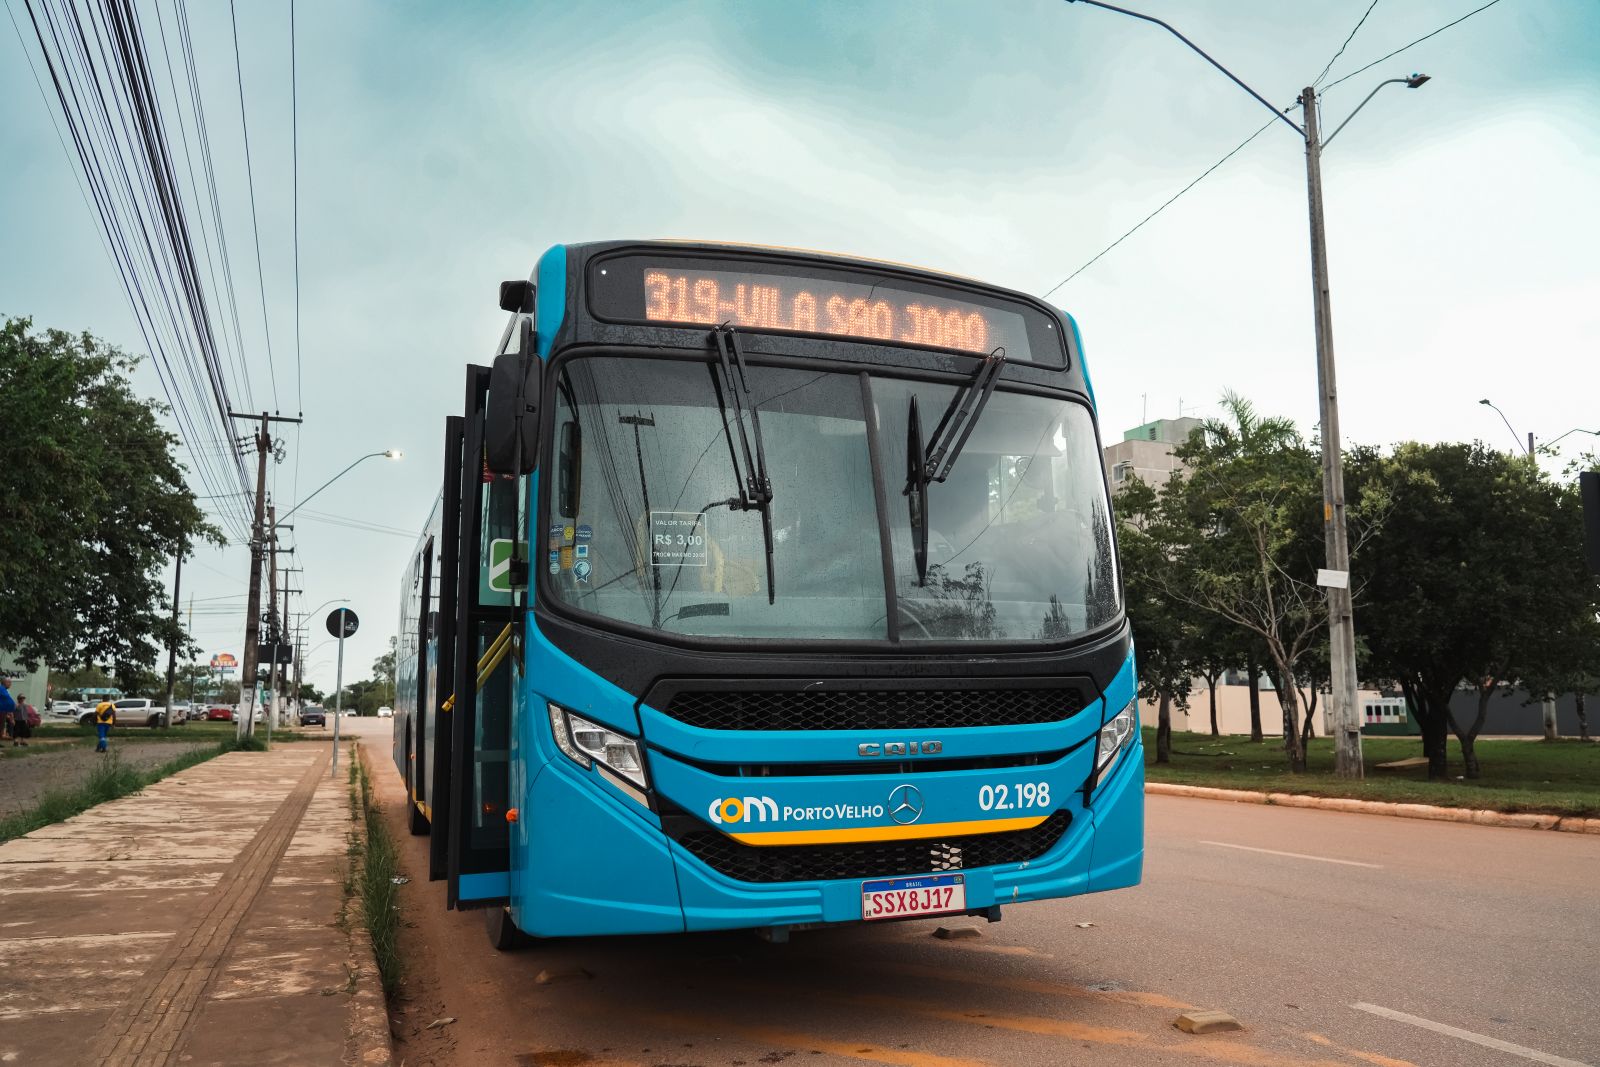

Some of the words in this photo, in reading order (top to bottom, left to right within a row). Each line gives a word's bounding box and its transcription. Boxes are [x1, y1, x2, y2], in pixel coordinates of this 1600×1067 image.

[655, 534, 672, 546] R$
[857, 740, 943, 757] CAIO
[978, 781, 1051, 812] 02.198
[872, 887, 954, 915] SSX8J17
